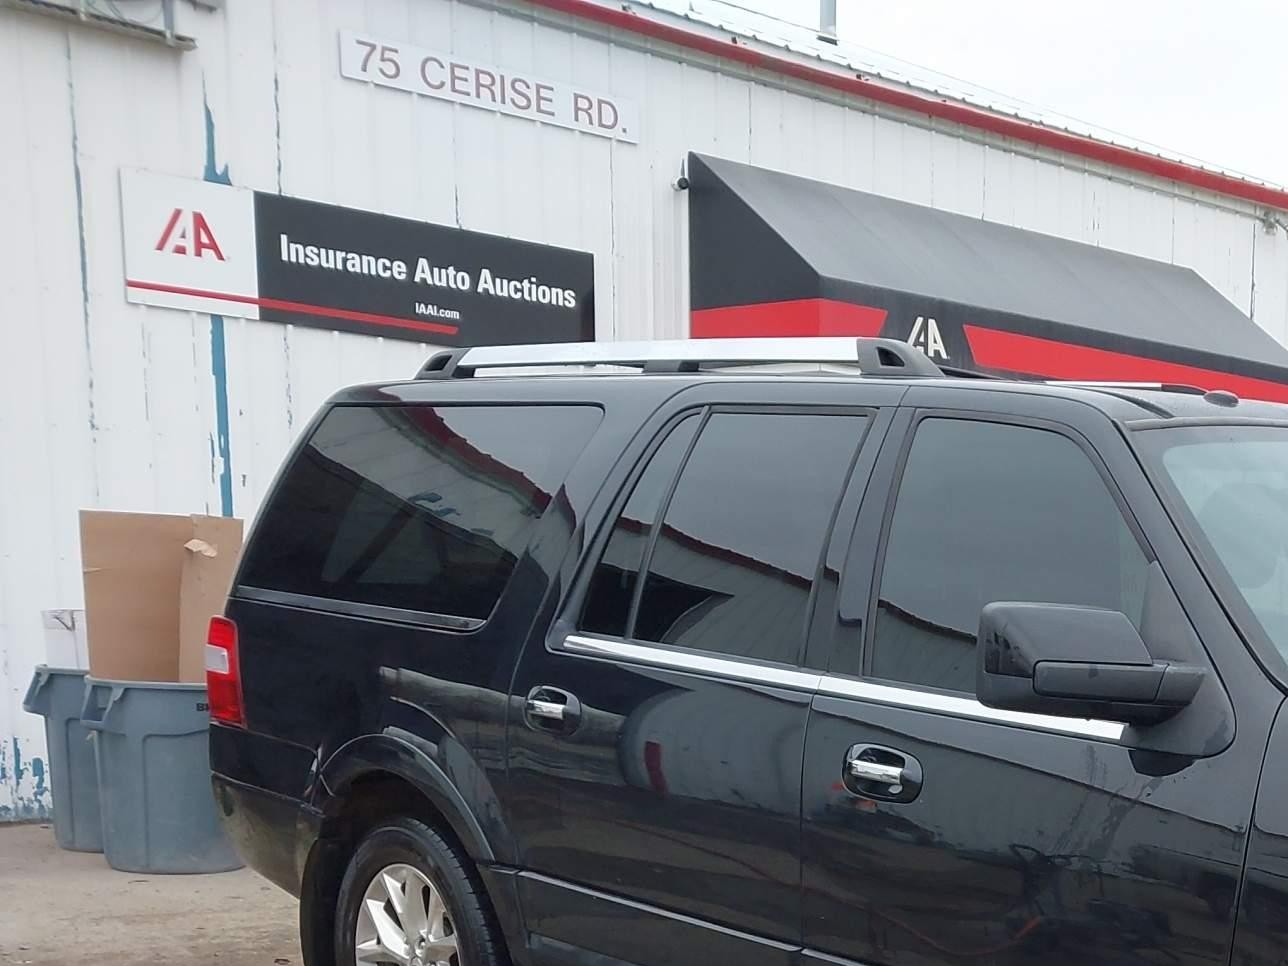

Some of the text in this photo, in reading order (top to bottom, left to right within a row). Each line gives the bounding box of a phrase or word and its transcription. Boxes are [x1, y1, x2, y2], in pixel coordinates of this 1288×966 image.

[355, 39, 627, 134] 75 CERISE RD.
[280, 234, 576, 308] Insurance Auto Auctions
[415, 302, 460, 320] IAAI.com
